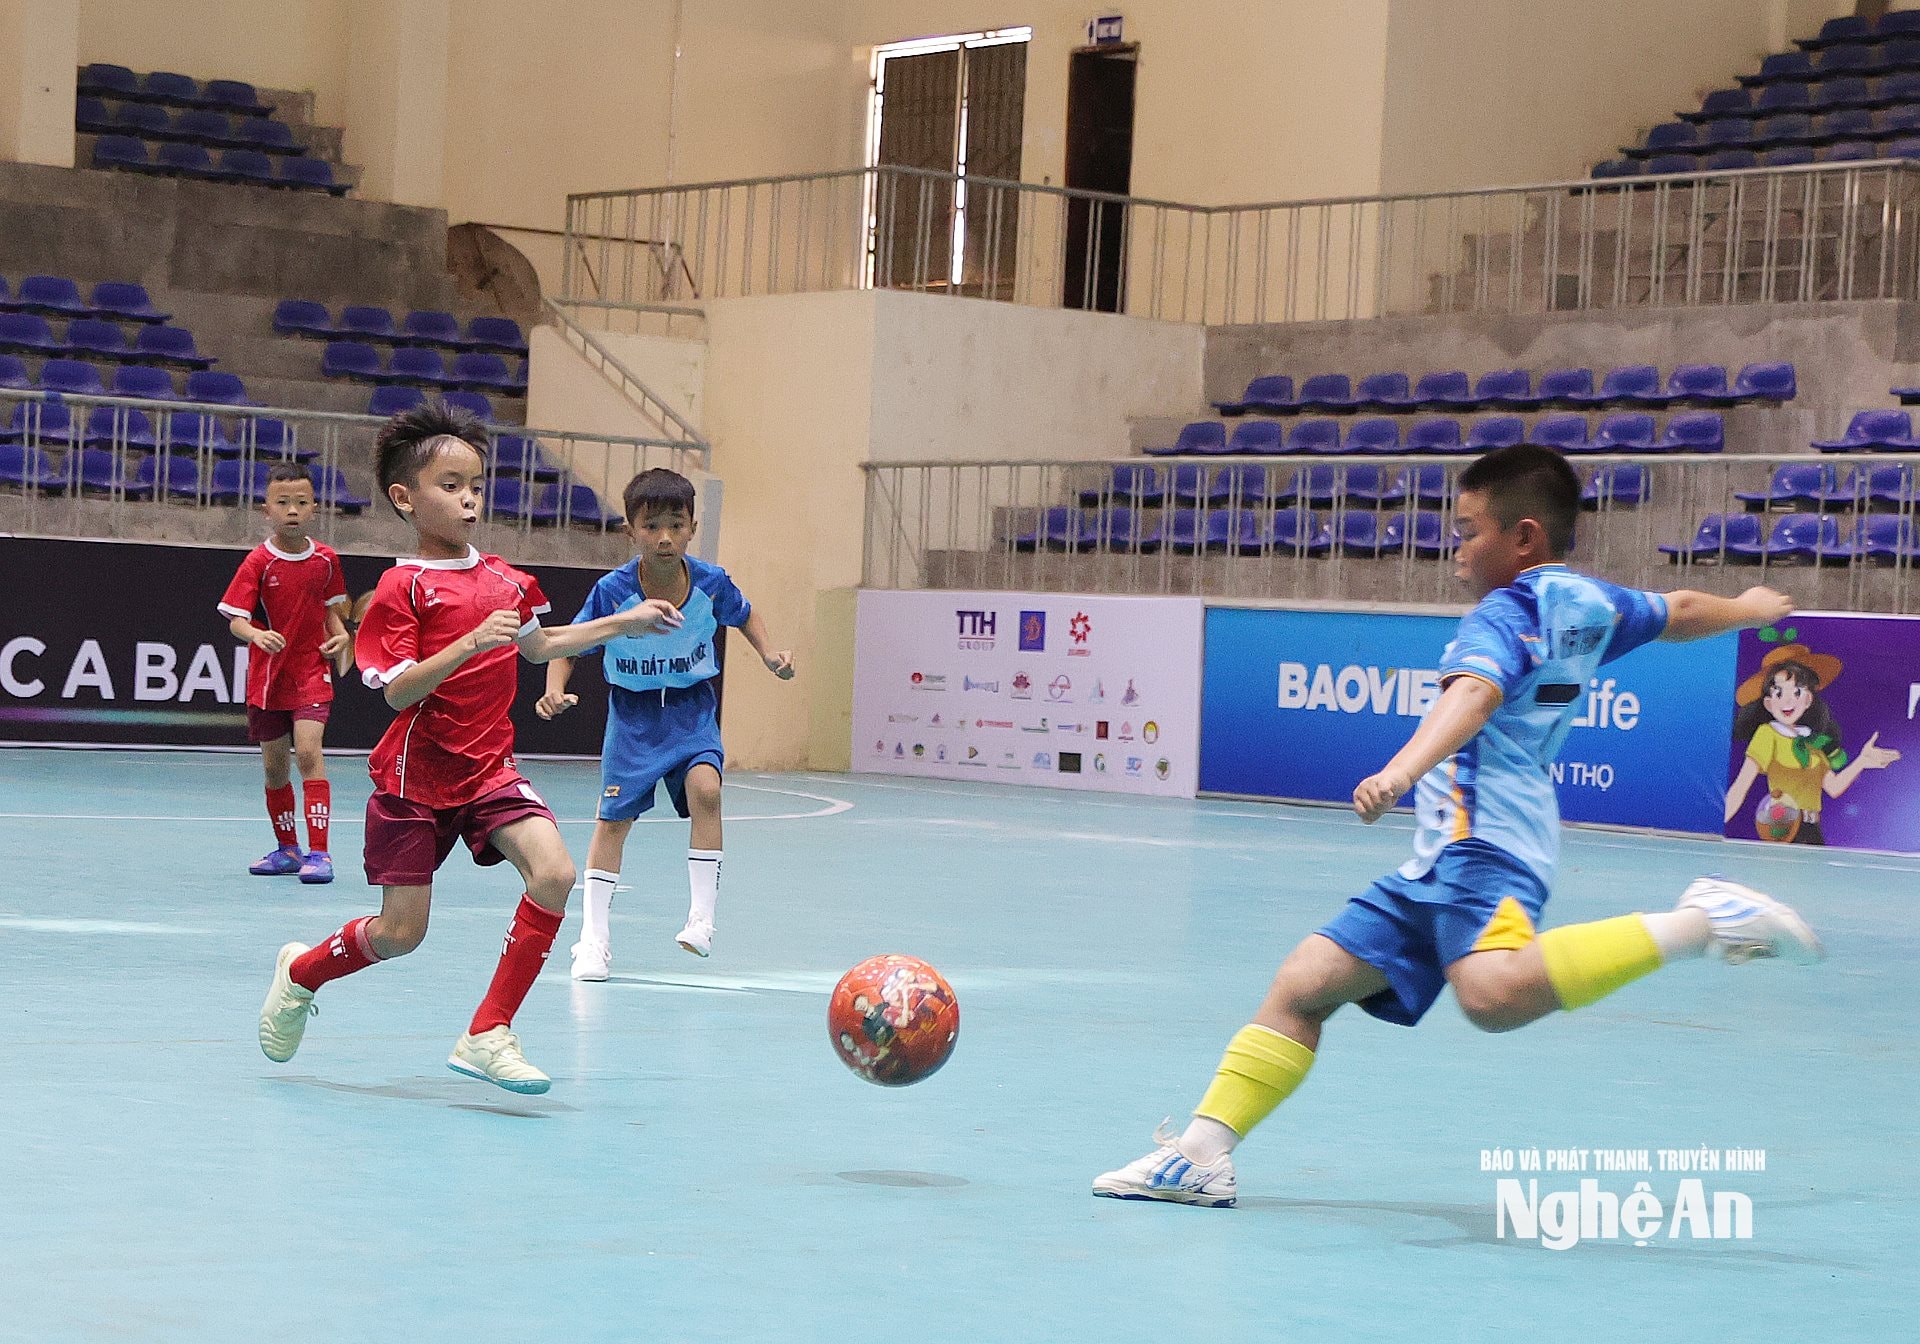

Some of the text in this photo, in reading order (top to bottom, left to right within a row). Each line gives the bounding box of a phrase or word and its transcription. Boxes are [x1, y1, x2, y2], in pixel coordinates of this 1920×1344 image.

[956, 611, 996, 635] TTH
[616, 656, 638, 675] NHÀ
[1278, 662, 1441, 716] BAOVIE
[1569, 762, 1615, 792] THỌ
